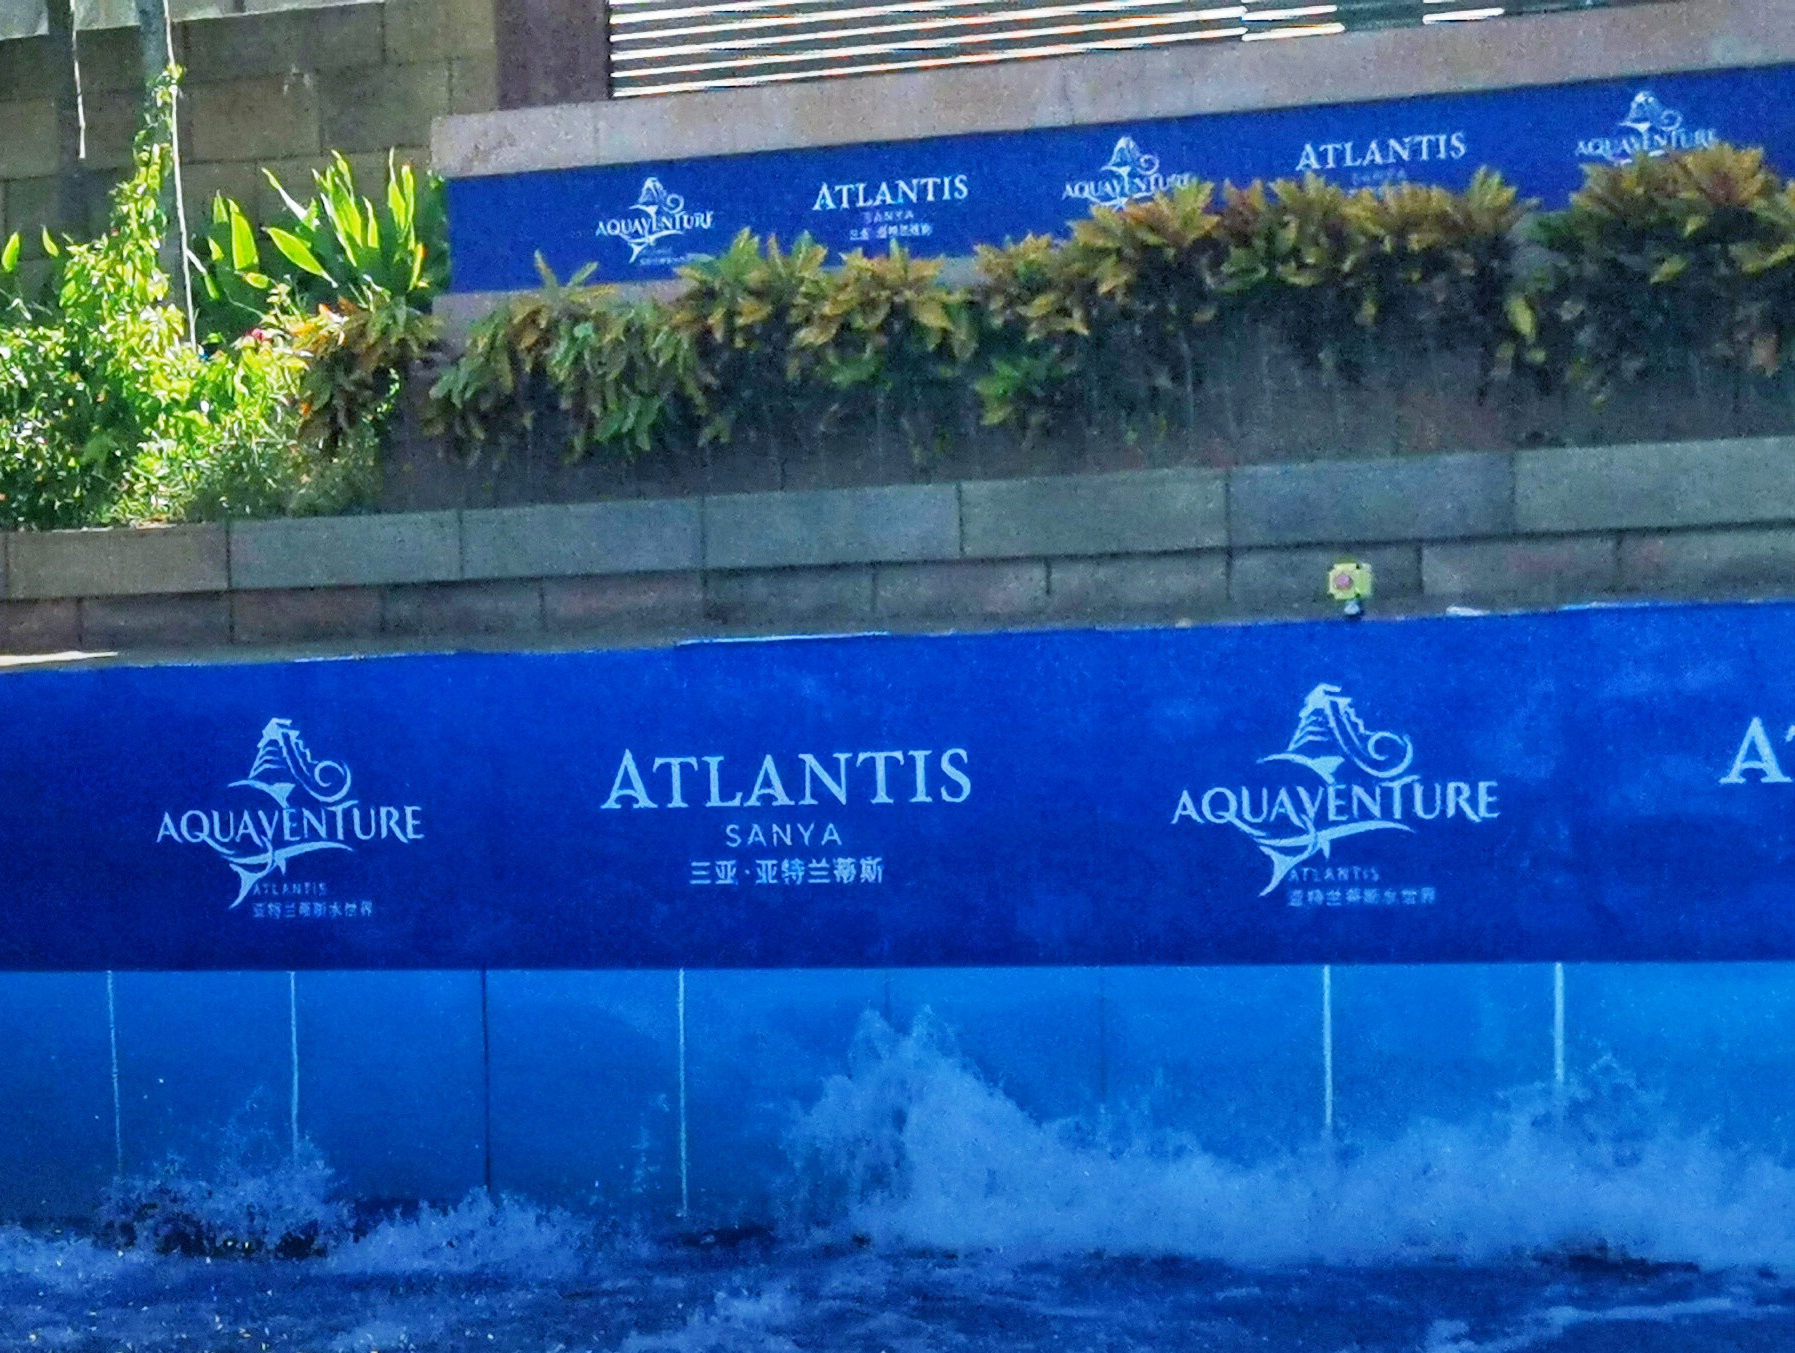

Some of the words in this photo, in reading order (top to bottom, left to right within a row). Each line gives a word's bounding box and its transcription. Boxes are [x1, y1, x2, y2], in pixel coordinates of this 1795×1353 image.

[1295, 131, 1467, 171] ATLANTIS
[811, 174, 968, 211] ATLANTIS
[1718, 716, 1795, 784] A
[600, 748, 972, 809] ATLANTIS
[156, 800, 425, 854] AQUAVENTURE
[1170, 774, 1500, 837] AQUAVENTURE
[725, 822, 843, 848] SANYA
[253, 881, 328, 896] ATLANTIS
